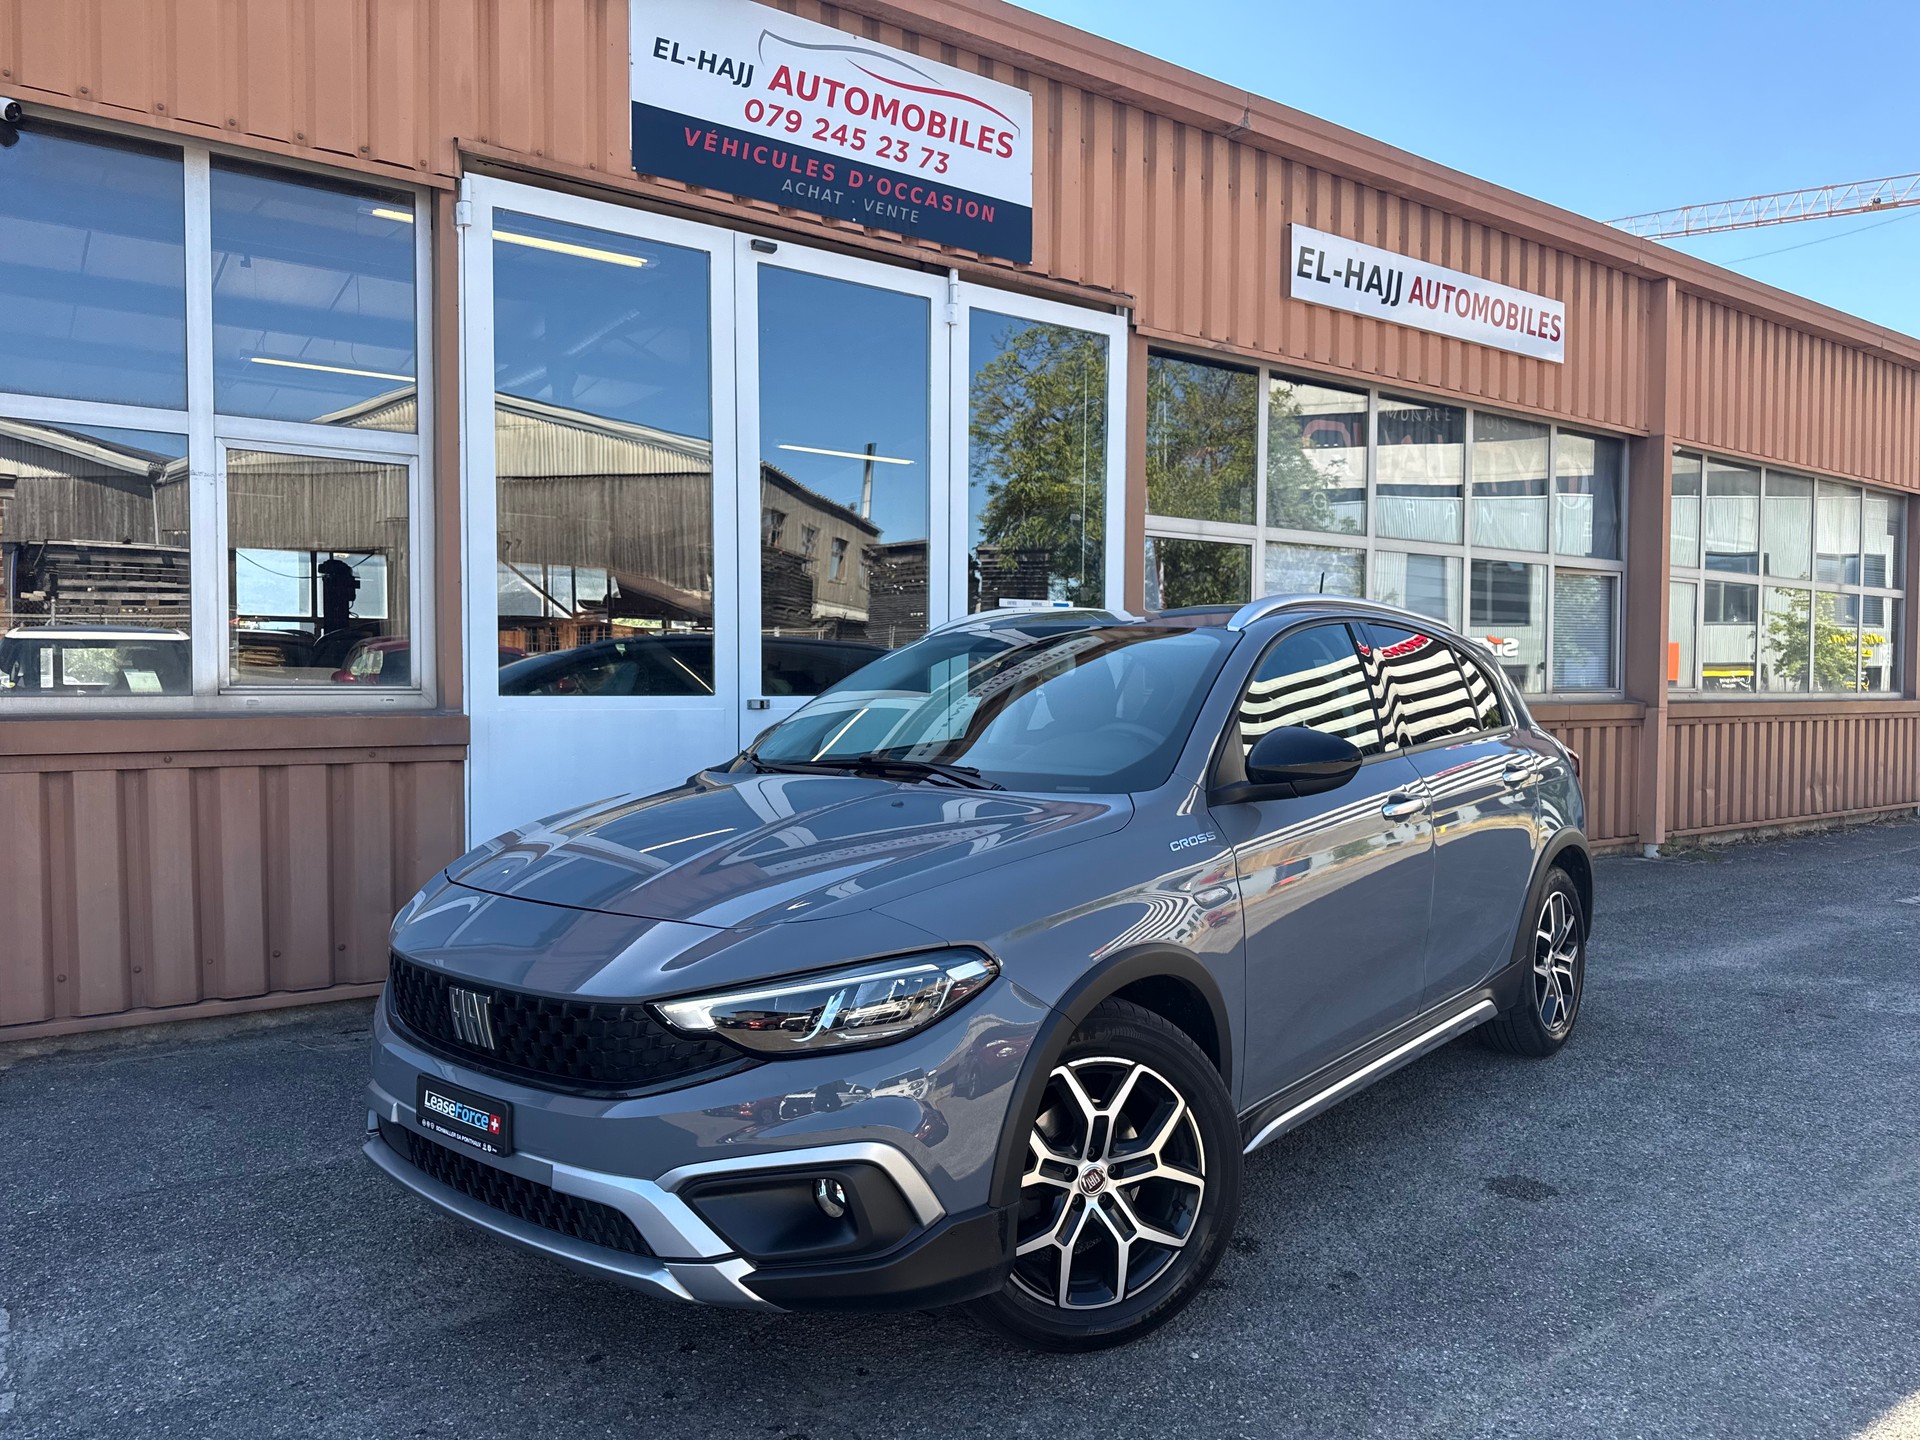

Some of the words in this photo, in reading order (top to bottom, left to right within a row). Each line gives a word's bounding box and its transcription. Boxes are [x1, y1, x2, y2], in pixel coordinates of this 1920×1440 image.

[652, 36, 755, 88] EL-HAJJ
[768, 64, 1015, 159] AUTOMOBILES
[744, 98, 803, 134] 079
[812, 117, 867, 151] 245
[876, 135, 909, 164] 23
[918, 147, 950, 174] 73
[684, 126, 835, 181] VÉHICULES
[848, 168, 996, 223] D'OCCASION
[781, 178, 844, 205] ACHAT
[863, 199, 919, 223] VENTE
[1296, 245, 1403, 307] EL-HAJJ
[1408, 275, 1562, 342] AUTOMOBILES
[1169, 831, 1217, 851] CROSS
[448, 986, 494, 1050] FIAT
[424, 1089, 489, 1129] LeaseForce
